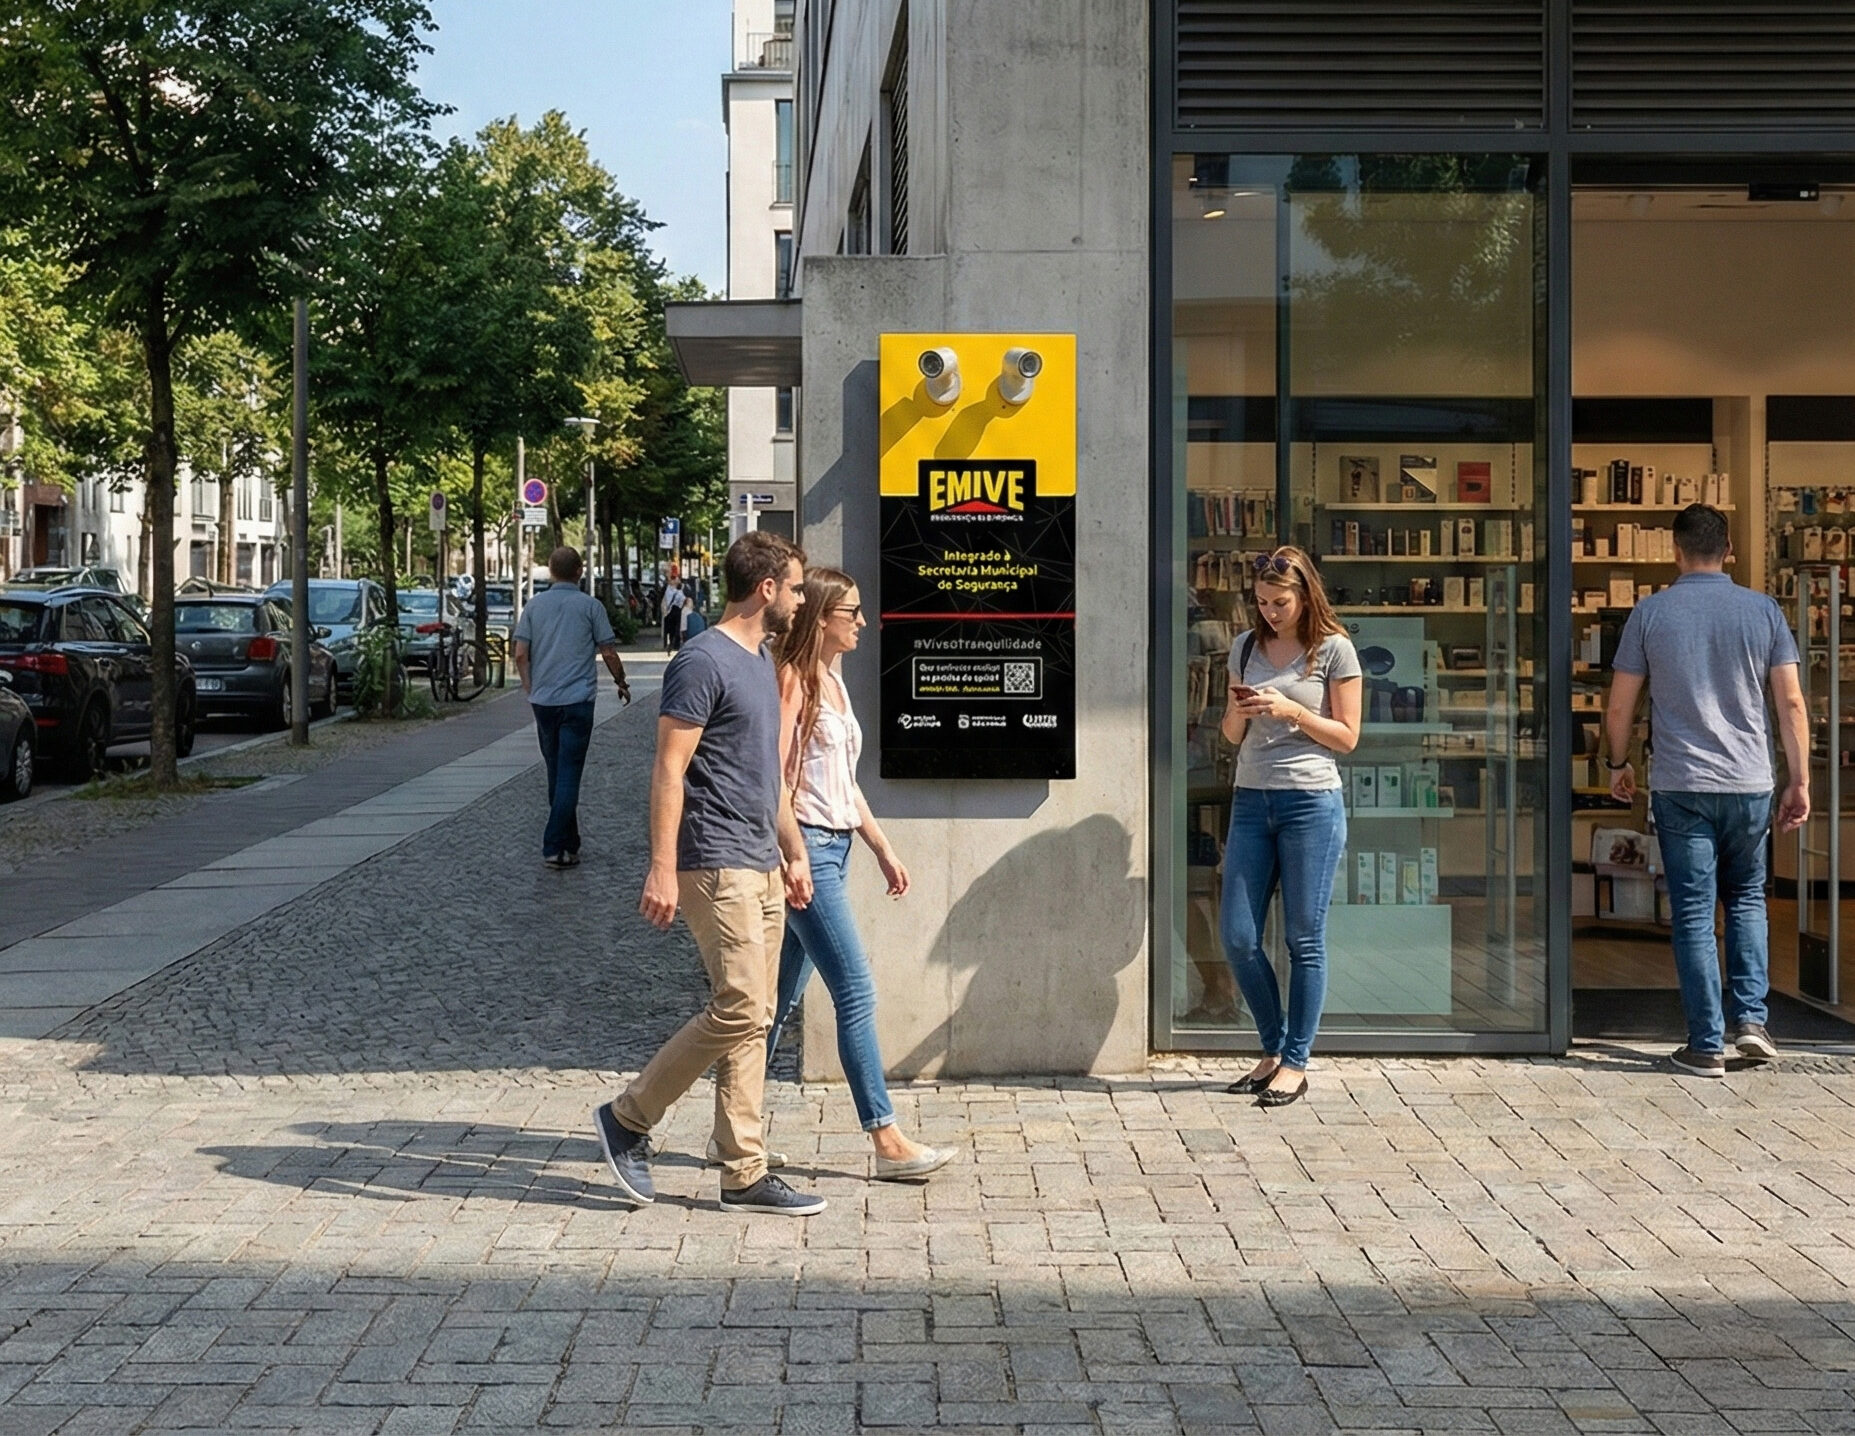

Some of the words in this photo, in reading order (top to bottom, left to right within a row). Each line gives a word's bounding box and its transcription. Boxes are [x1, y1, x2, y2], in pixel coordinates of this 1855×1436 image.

[929, 470, 1024, 512] EMIVE
[944, 550, 1001, 564] Integrado
[980, 563, 1038, 578] Municipal
[955, 579, 1018, 593] Segurança
